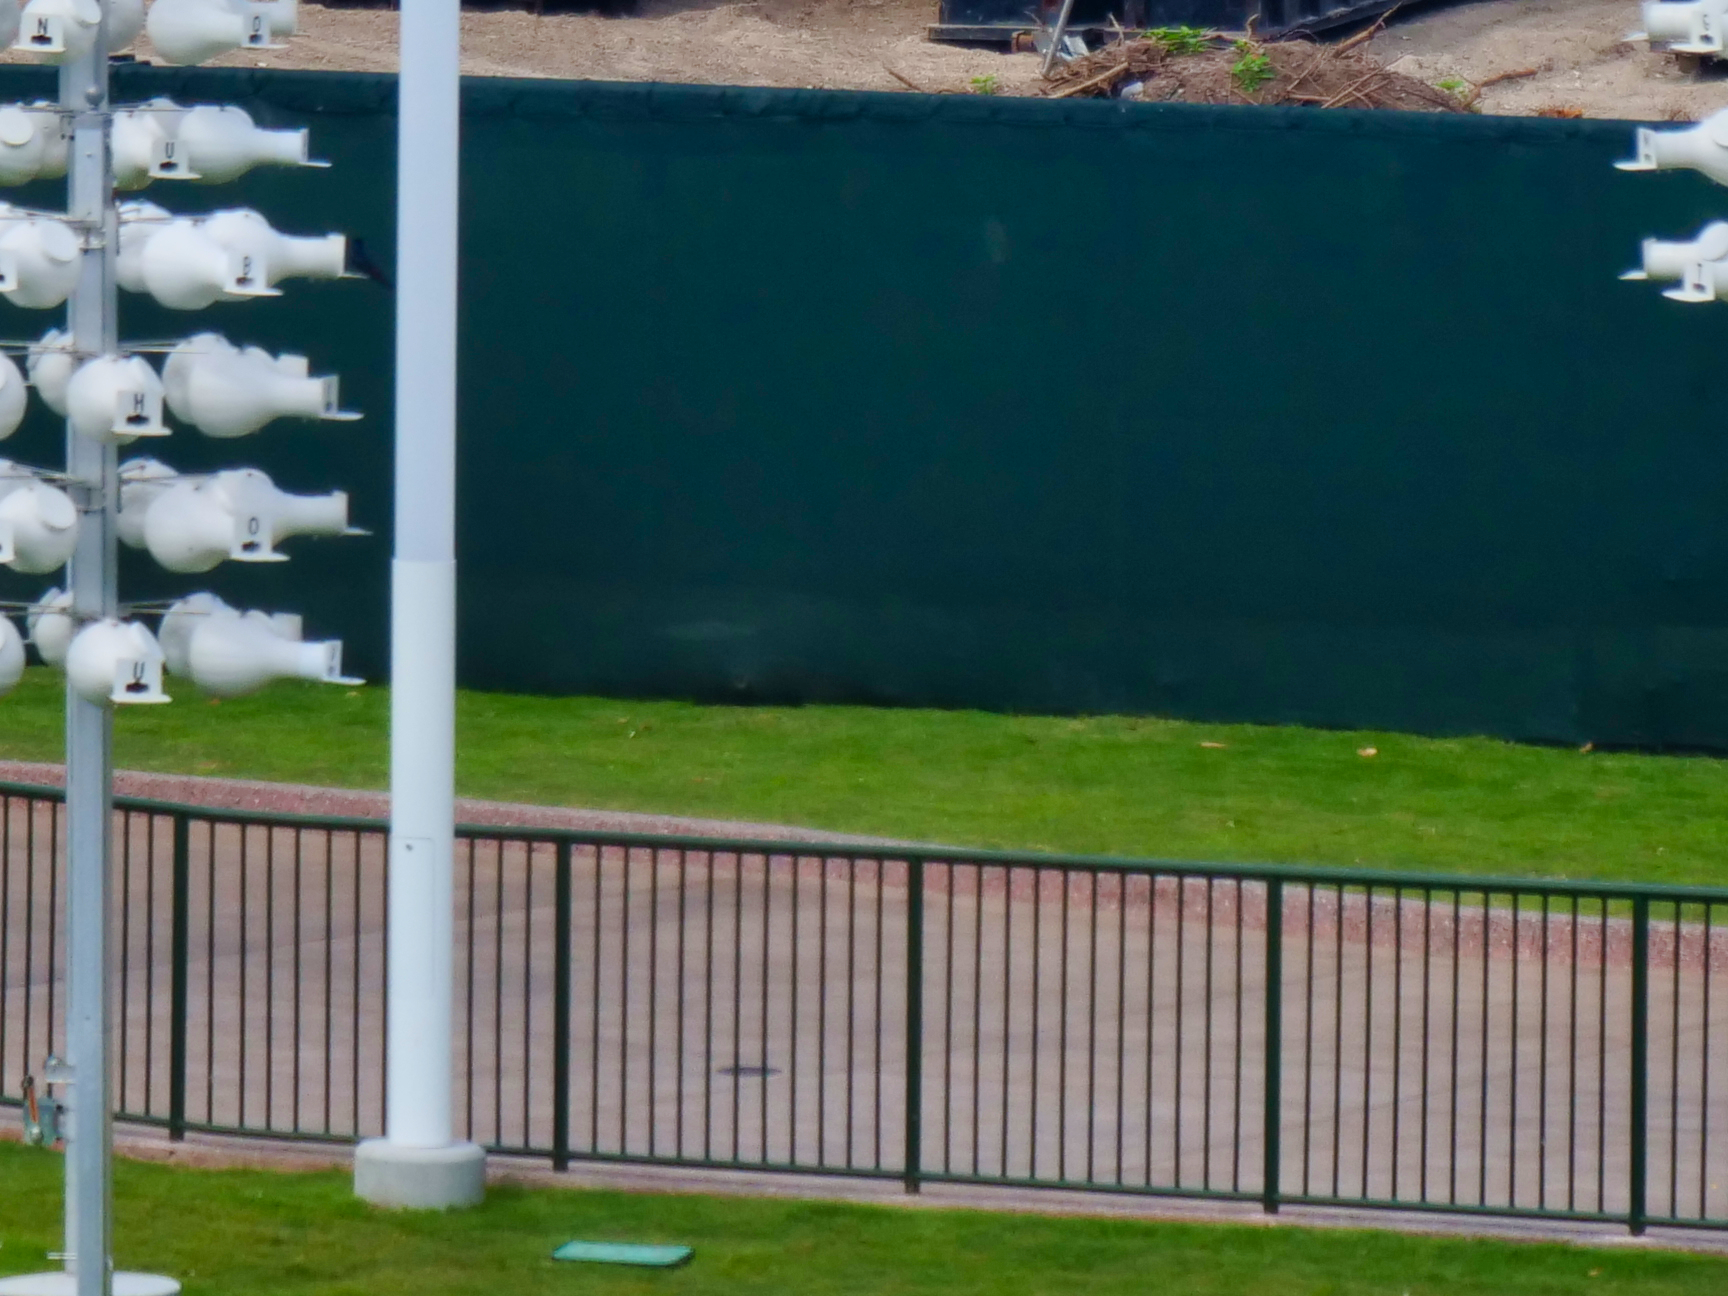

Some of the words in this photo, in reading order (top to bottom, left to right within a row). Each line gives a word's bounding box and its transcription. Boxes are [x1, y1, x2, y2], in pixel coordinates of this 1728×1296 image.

[37, 17, 48, 35] N
[166, 142, 175, 159] U
[134, 393, 144, 413] H
[133, 661, 145, 681] U
